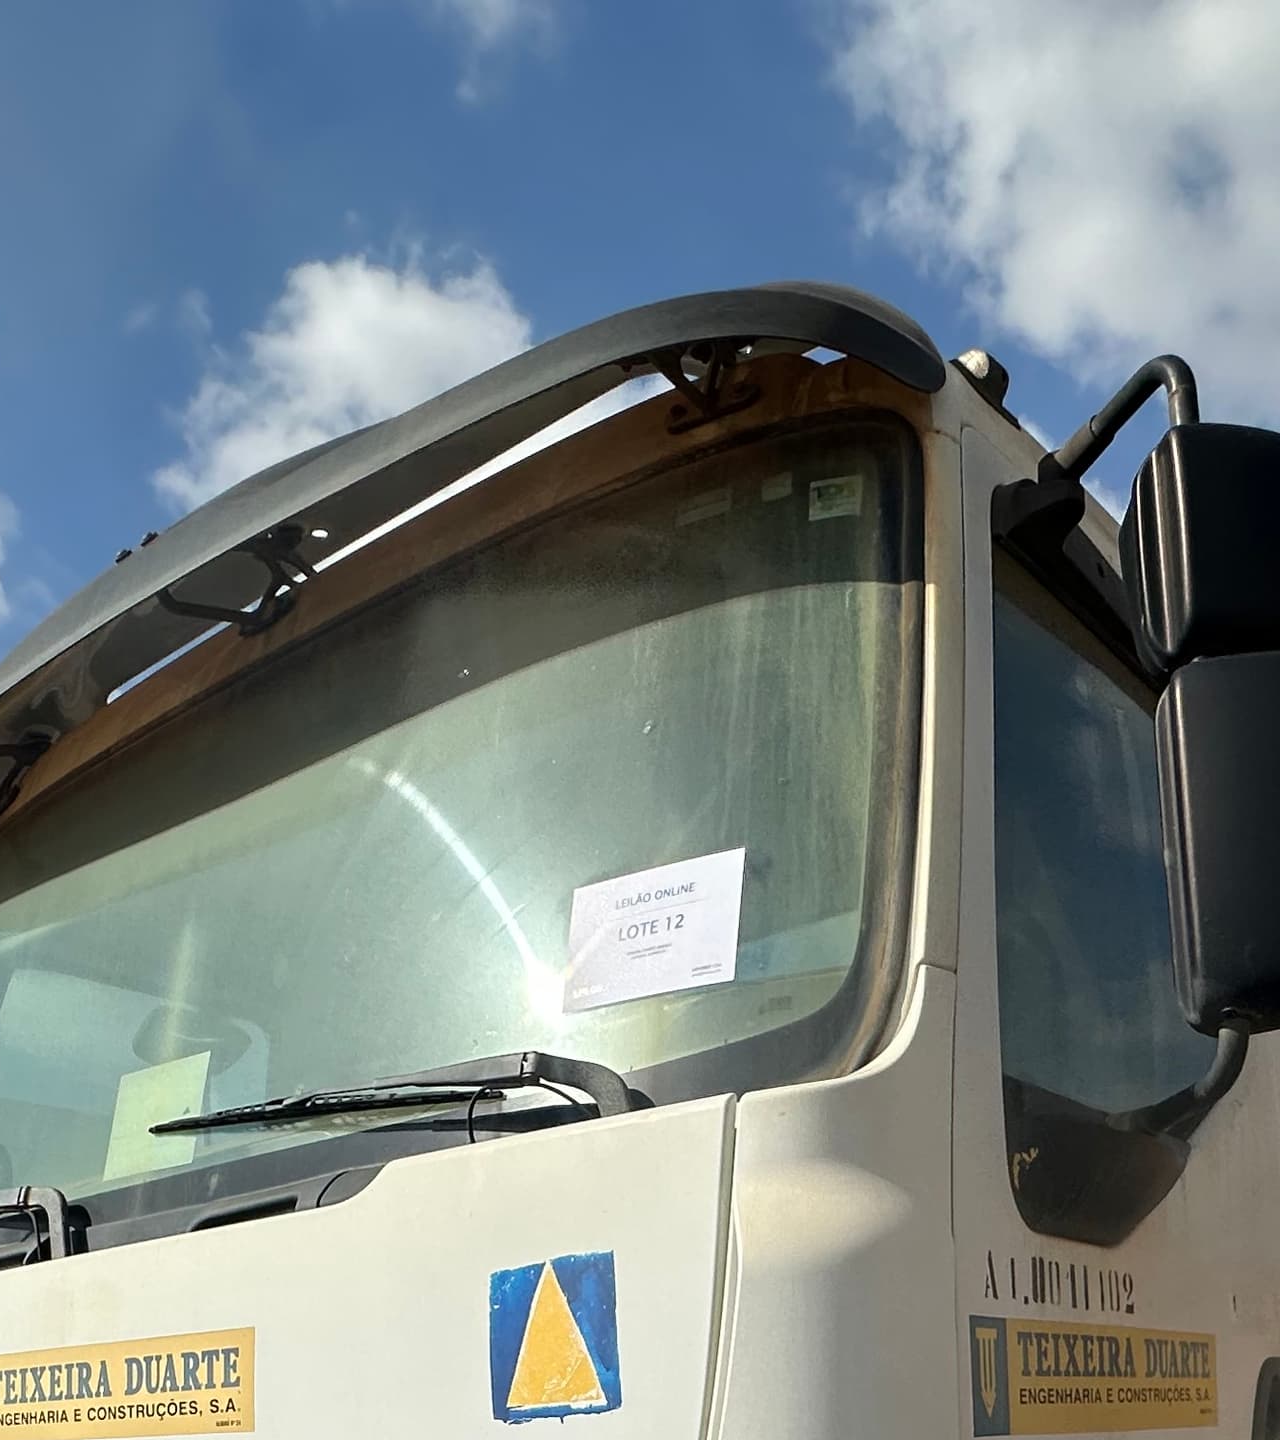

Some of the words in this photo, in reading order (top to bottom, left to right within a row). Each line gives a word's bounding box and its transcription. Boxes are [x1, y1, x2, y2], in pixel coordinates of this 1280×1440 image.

[615, 892, 652, 910] LEILÃO
[655, 882, 696, 900] ONLINE
[618, 919, 659, 942] LOTE
[666, 914, 685, 932] 12
[1017, 1331, 1136, 1378] TEIXEIRA
[1143, 1338, 1211, 1379] DUARTE
[124, 1347, 241, 1397] DUARTE
[1019, 1387, 1103, 1405] ENGENHARIA
[1106, 1389, 1114, 1403] E
[74, 1408, 82, 1422] E
